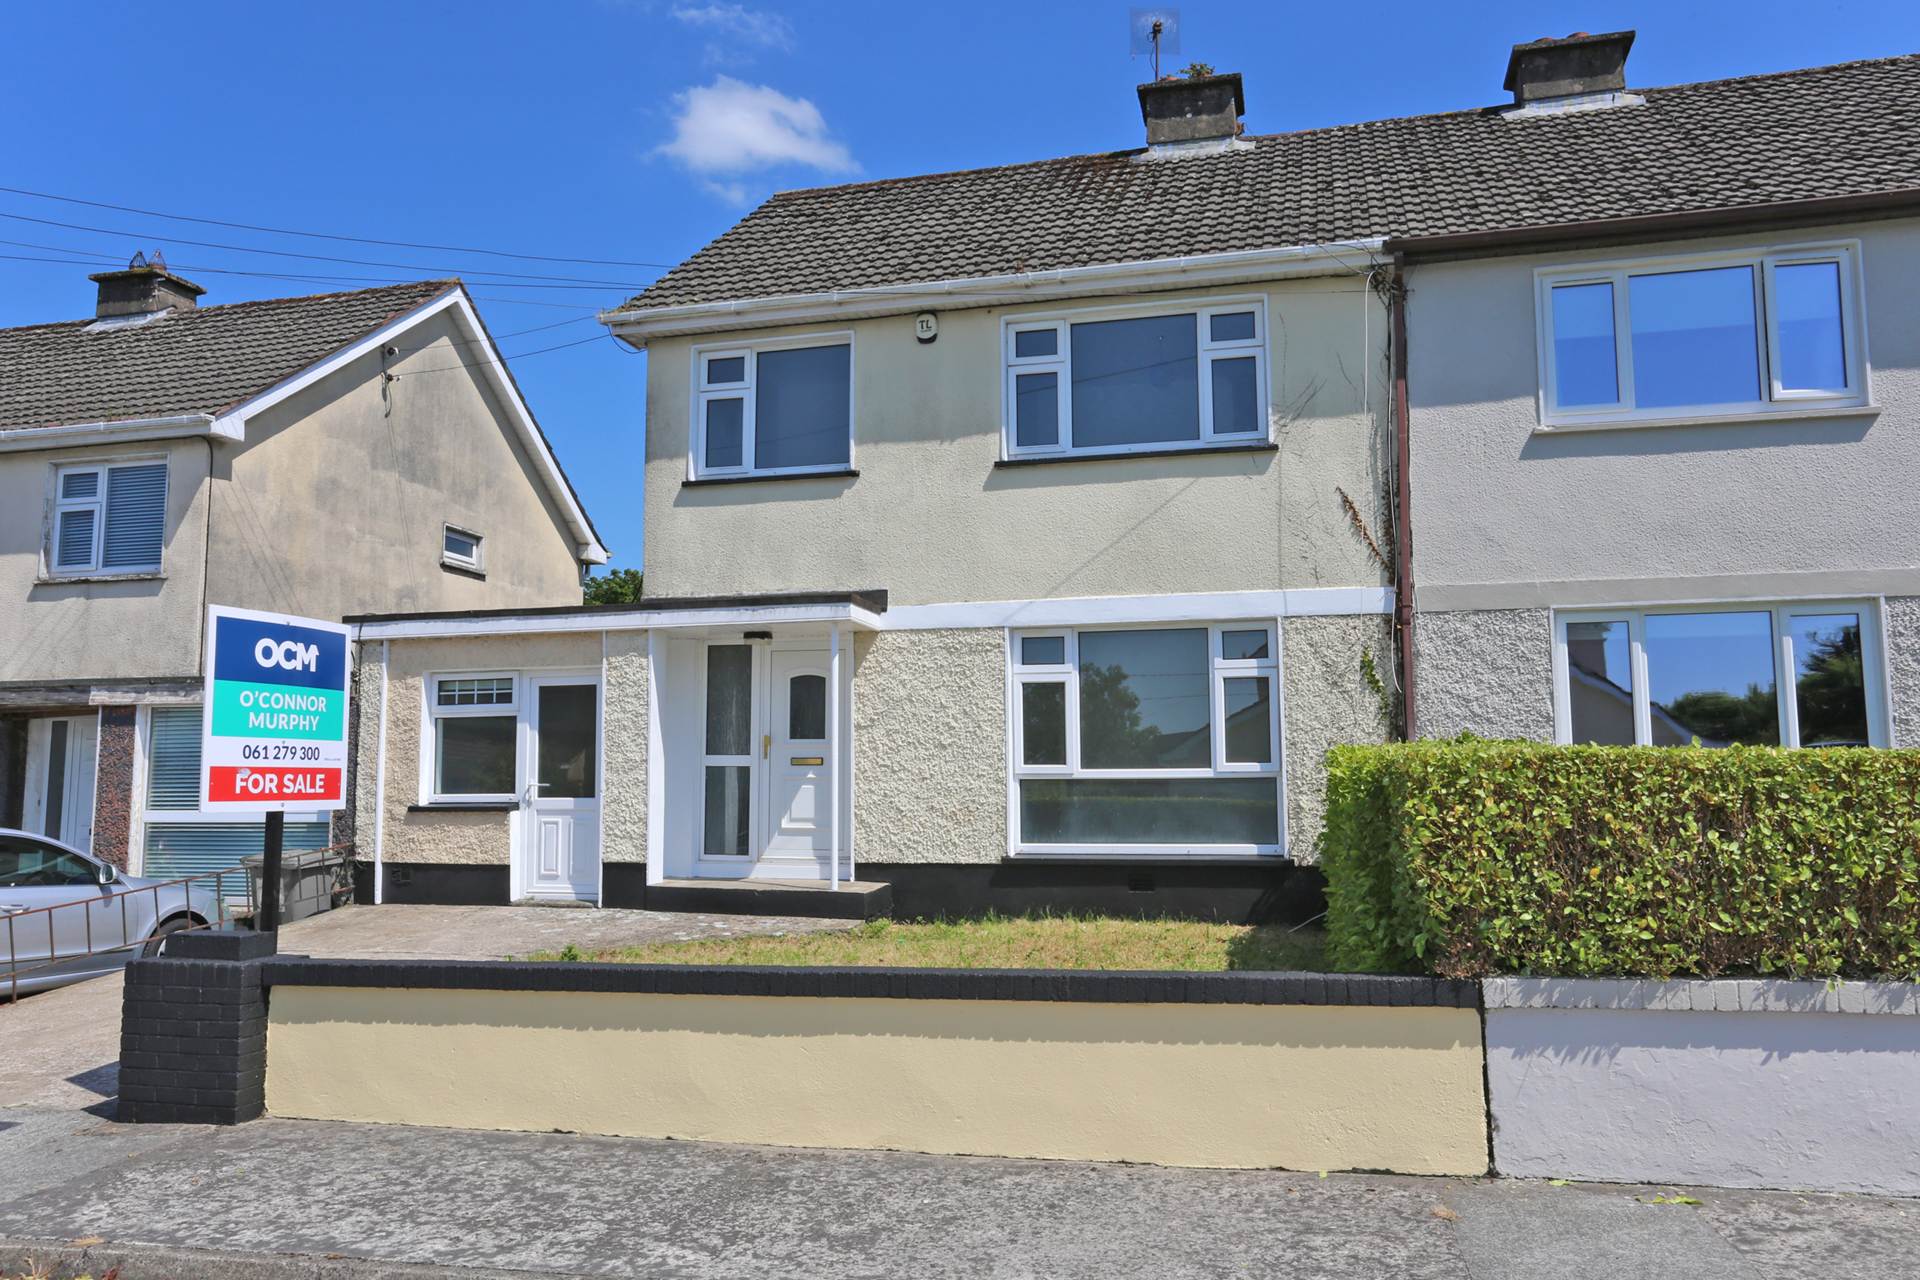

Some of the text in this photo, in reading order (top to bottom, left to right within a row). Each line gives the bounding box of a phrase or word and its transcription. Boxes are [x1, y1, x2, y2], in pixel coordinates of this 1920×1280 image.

[918, 319, 932, 330] TL
[254, 637, 320, 673] OCM
[239, 690, 327, 712] O'CONNOR
[248, 711, 320, 731] MURPHY
[242, 744, 320, 761] 061 279 300
[235, 773, 326, 795] FOR SALE
